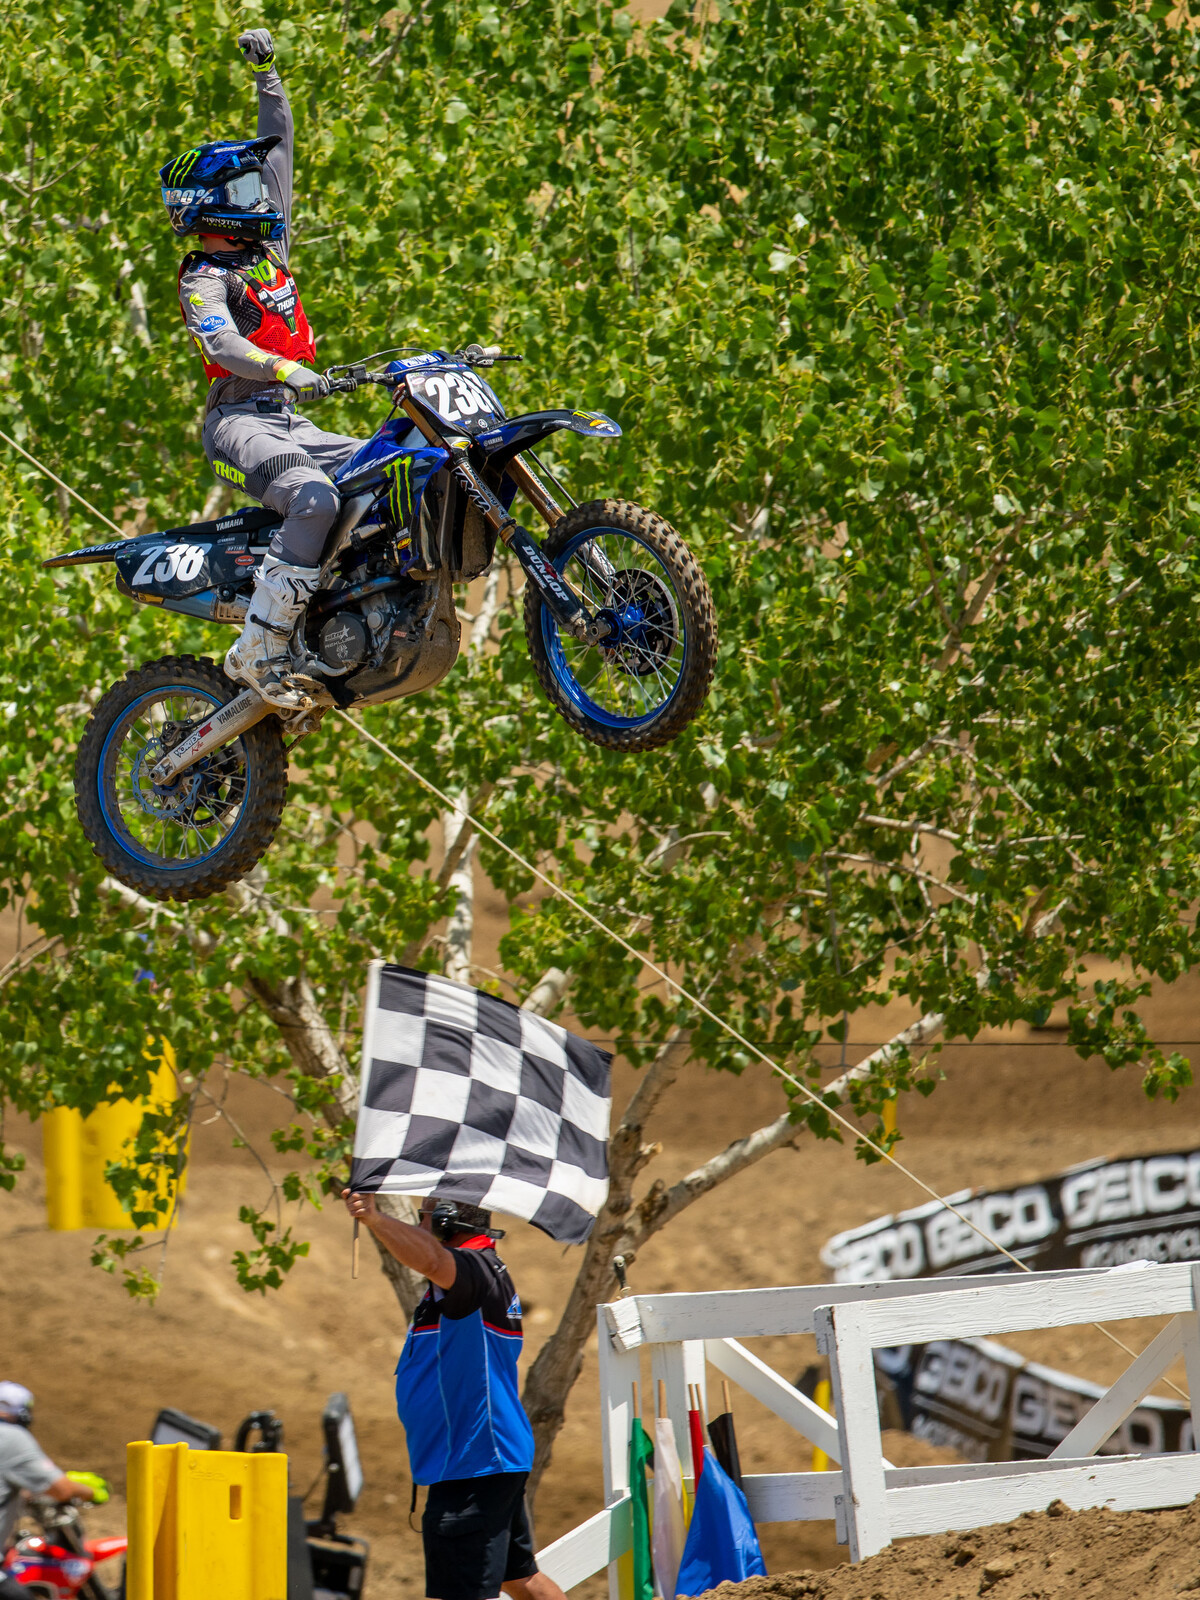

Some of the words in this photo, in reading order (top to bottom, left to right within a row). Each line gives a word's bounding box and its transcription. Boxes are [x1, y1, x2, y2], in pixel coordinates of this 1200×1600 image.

[213, 459, 246, 488] THOR
[215, 517, 244, 532] YAMAHA
[132, 543, 213, 587] 238
[522, 545, 570, 602] DUNLOP
[216, 696, 253, 725] YAMALUBE
[1061, 1151, 1200, 1230] GEIC
